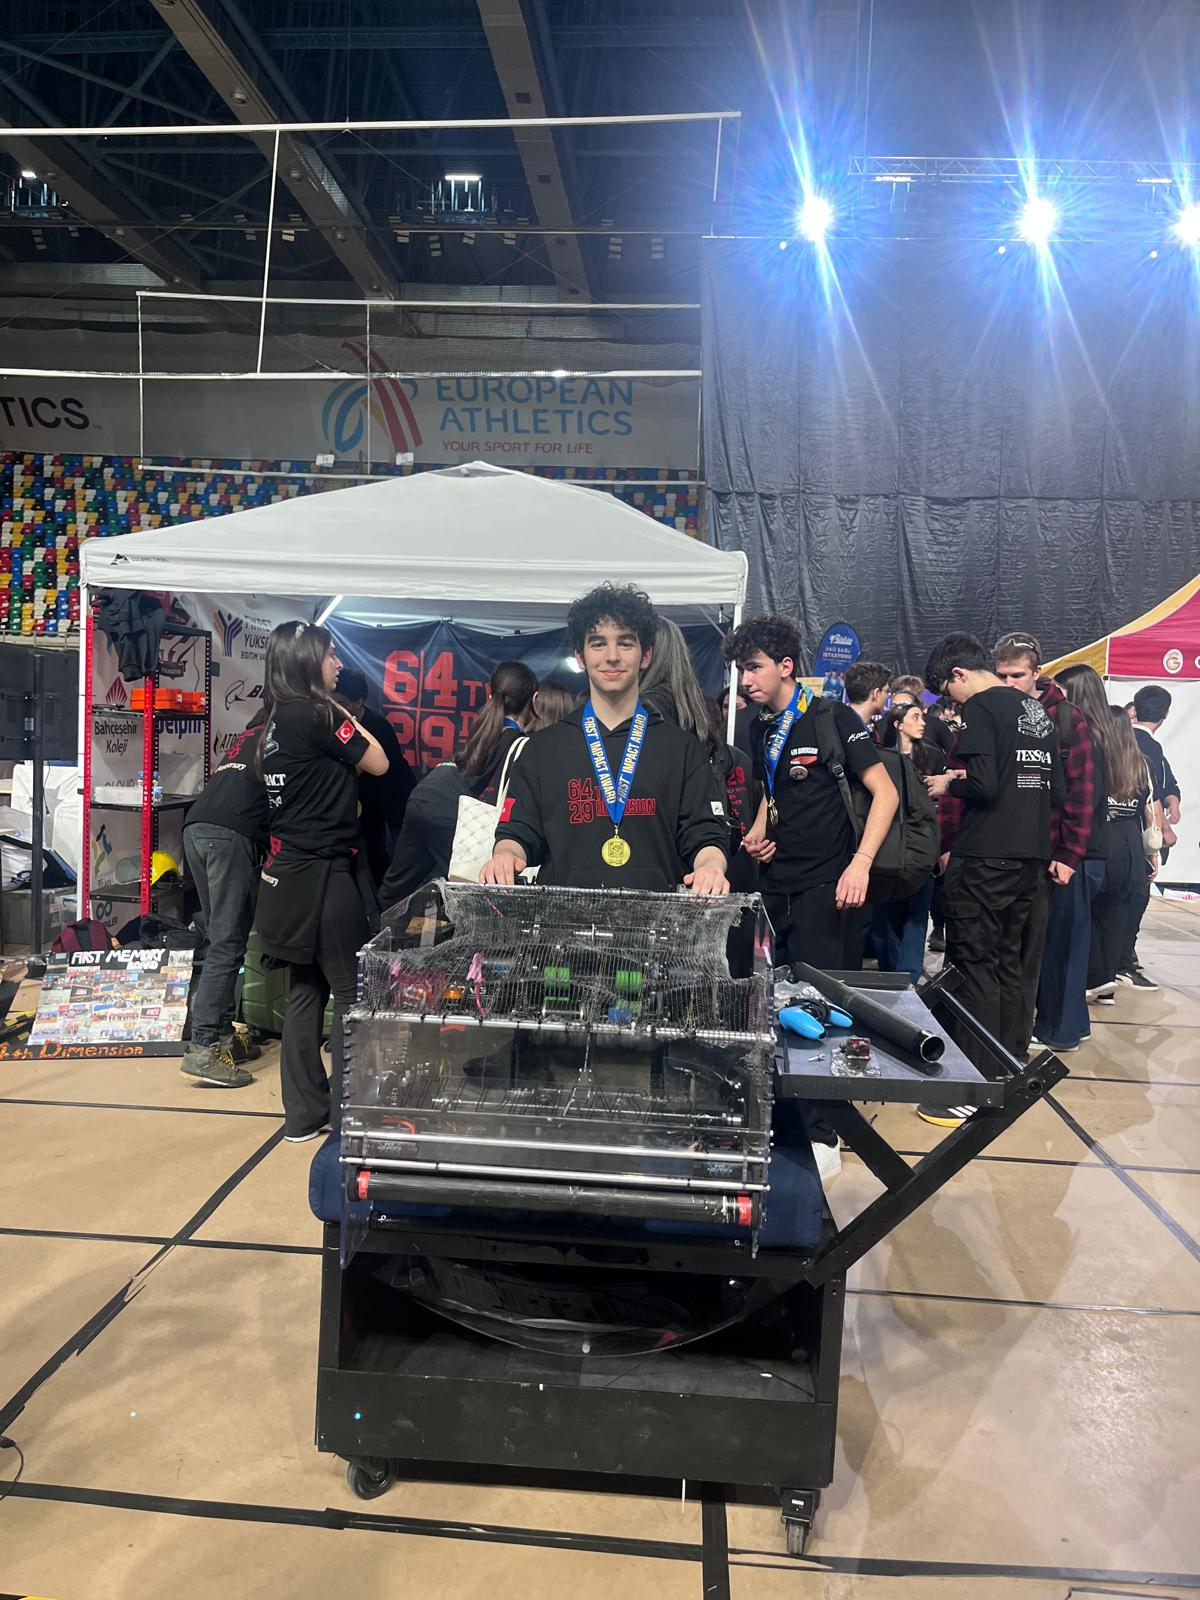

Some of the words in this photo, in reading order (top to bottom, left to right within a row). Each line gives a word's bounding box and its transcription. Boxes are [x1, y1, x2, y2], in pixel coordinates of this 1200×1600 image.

[436, 377, 633, 405] EUROPEAN
[0, 396, 90, 430] TICS
[439, 407, 633, 436] ATHLETICS
[442, 440, 480, 452] YOUR
[484, 441, 530, 453] SPORT
[534, 442, 562, 453] FOR
[567, 443, 593, 454] LIFE
[383, 650, 458, 708] 64
[94, 720, 138, 738] Bahçeşehir
[105, 739, 129, 757] Koleji
[622, 743, 640, 774] IMPACT
[631, 714, 647, 743] AWARD
[589, 741, 608, 772] IMPACT
[599, 773, 617, 804] AWARD
[71, 951, 104, 964] FIRST
[105, 948, 166, 963] MEMORY
[39, 1040, 144, 1058] Dimension
